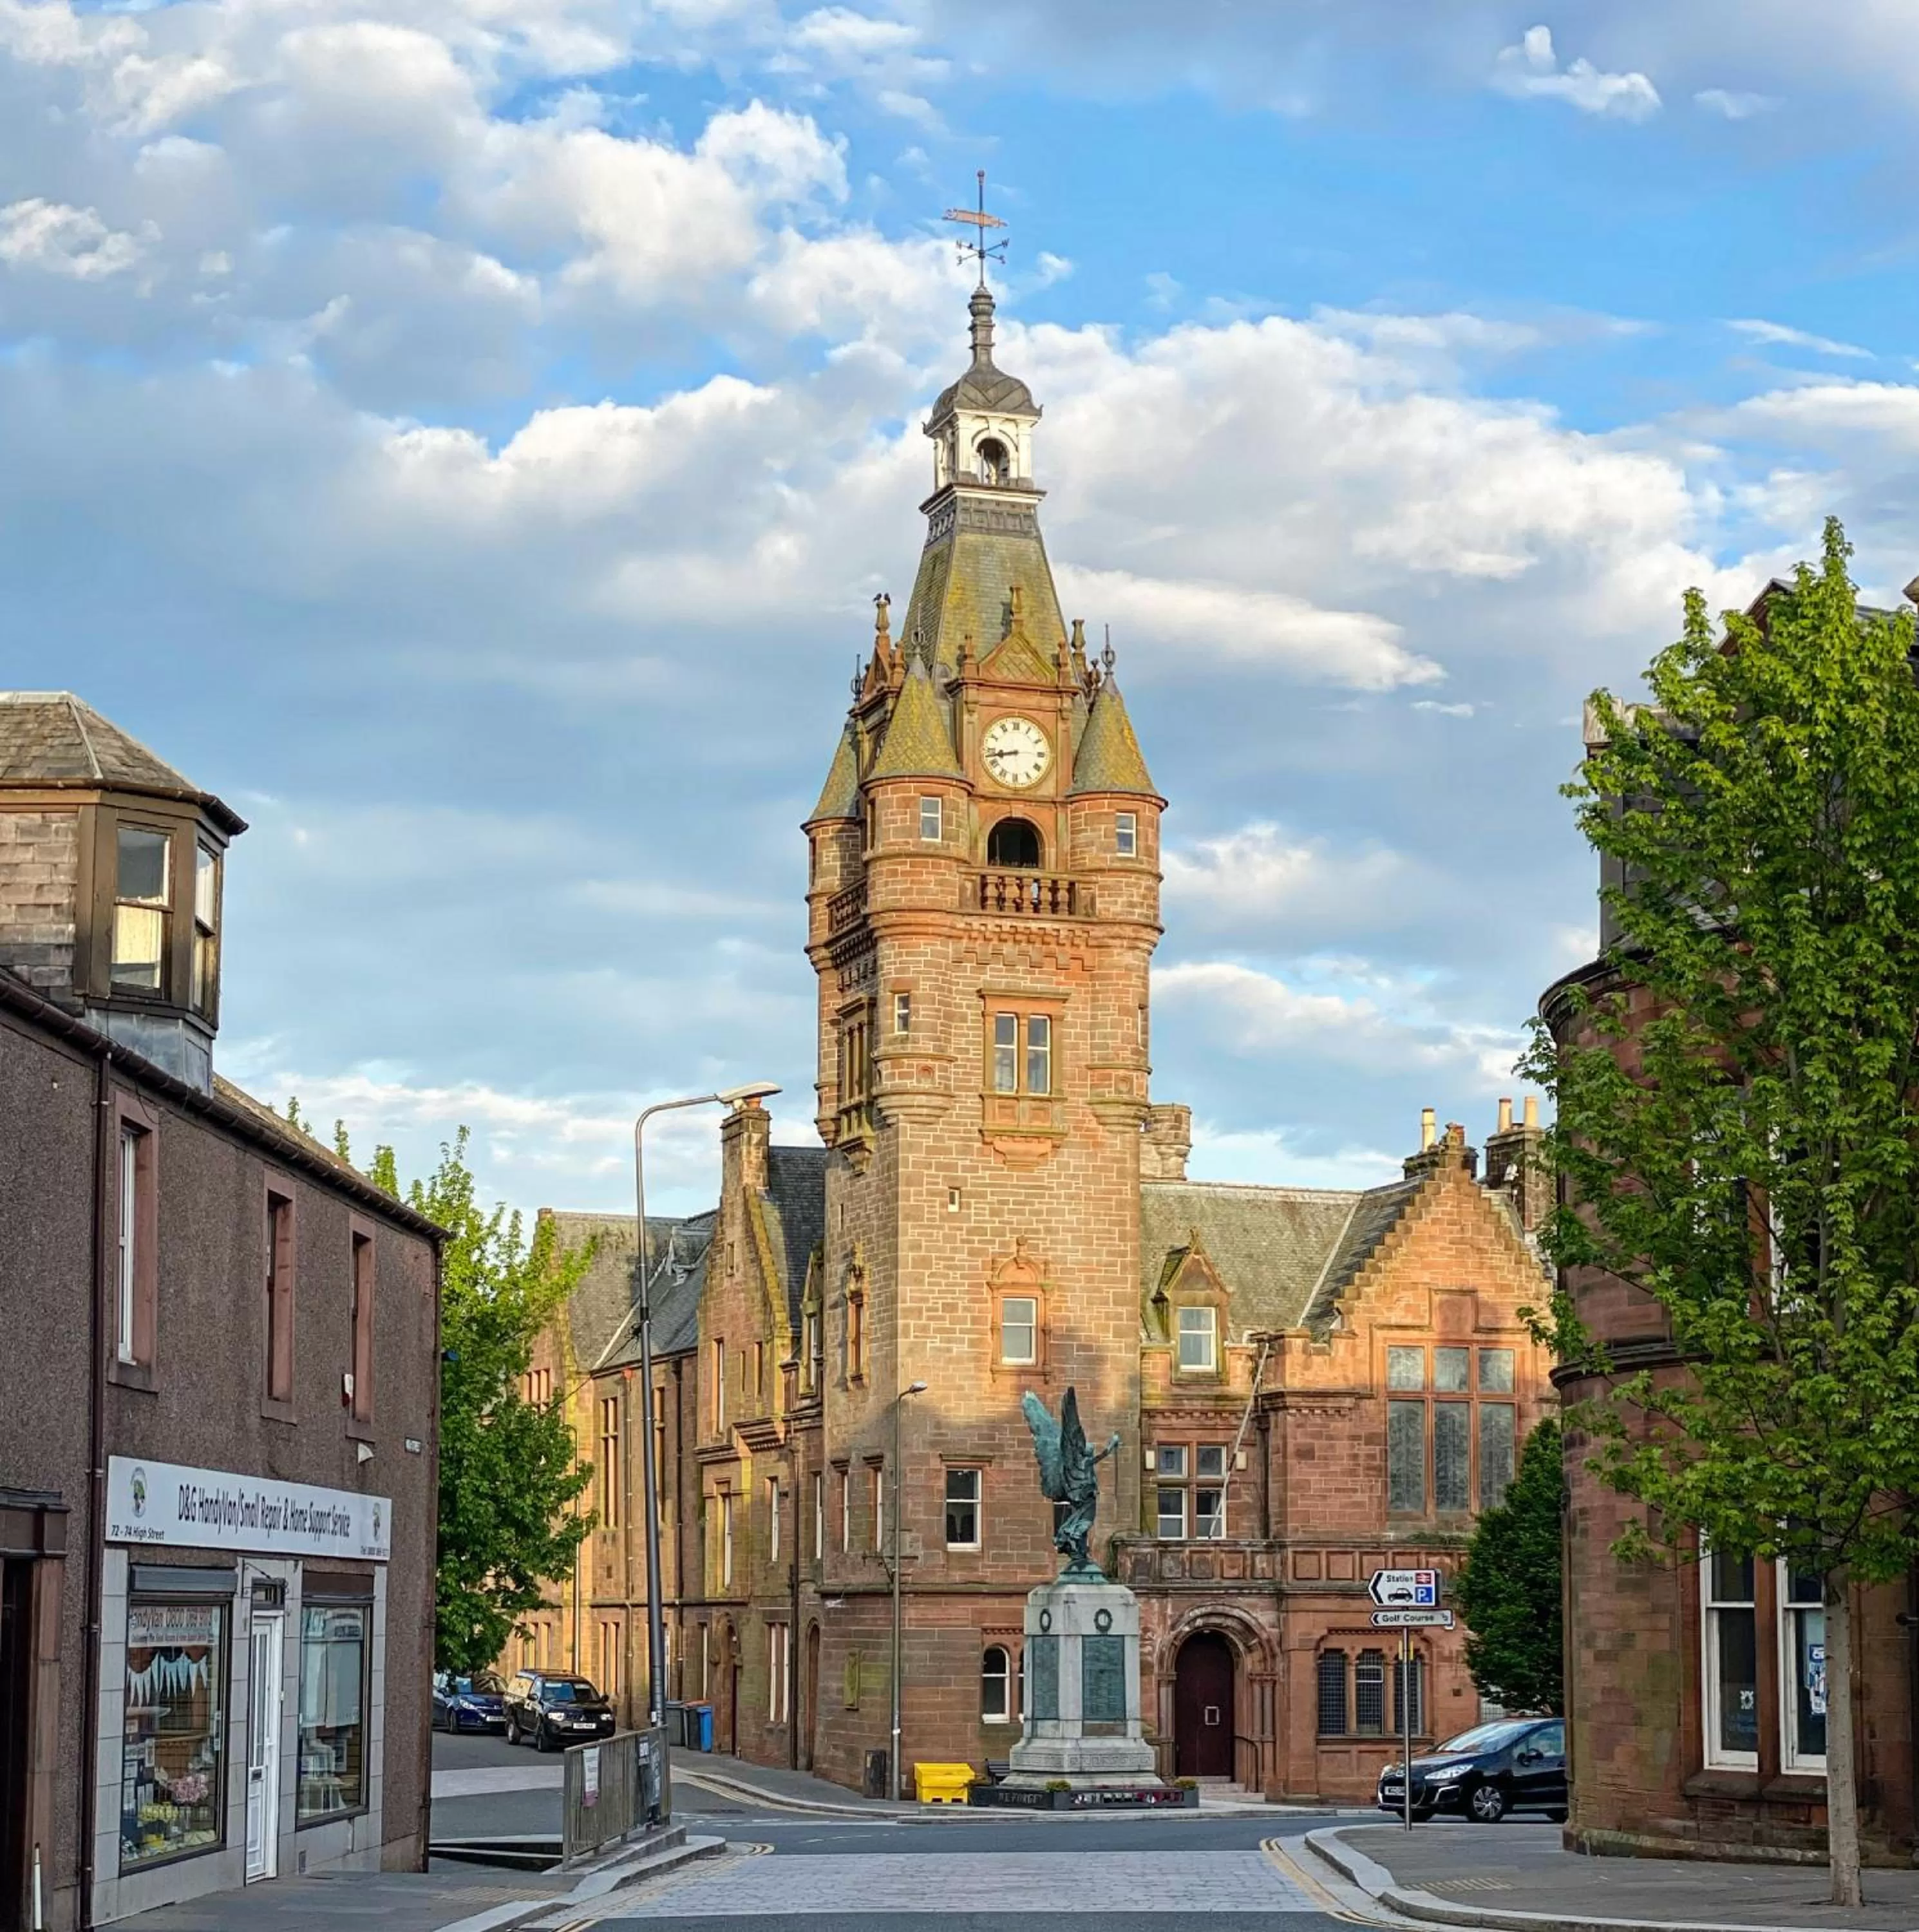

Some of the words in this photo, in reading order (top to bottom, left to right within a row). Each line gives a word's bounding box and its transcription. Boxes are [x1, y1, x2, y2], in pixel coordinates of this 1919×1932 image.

[178, 1484, 196, 1522] D&G
[260, 1495, 282, 1539] Repair
[283, 1496, 289, 1531] &
[289, 1499, 308, 1533] Home
[309, 1501, 331, 1542] Support
[332, 1504, 350, 1537] Service
[111, 1524, 119, 1536] 72
[133, 1525, 147, 1540] High
[147, 1526, 165, 1540] Street
[1386, 1574, 1413, 1583] Station
[1417, 1589, 1427, 1602] P
[1382, 1614, 1400, 1622] Golf
[1403, 1614, 1435, 1622] Course
